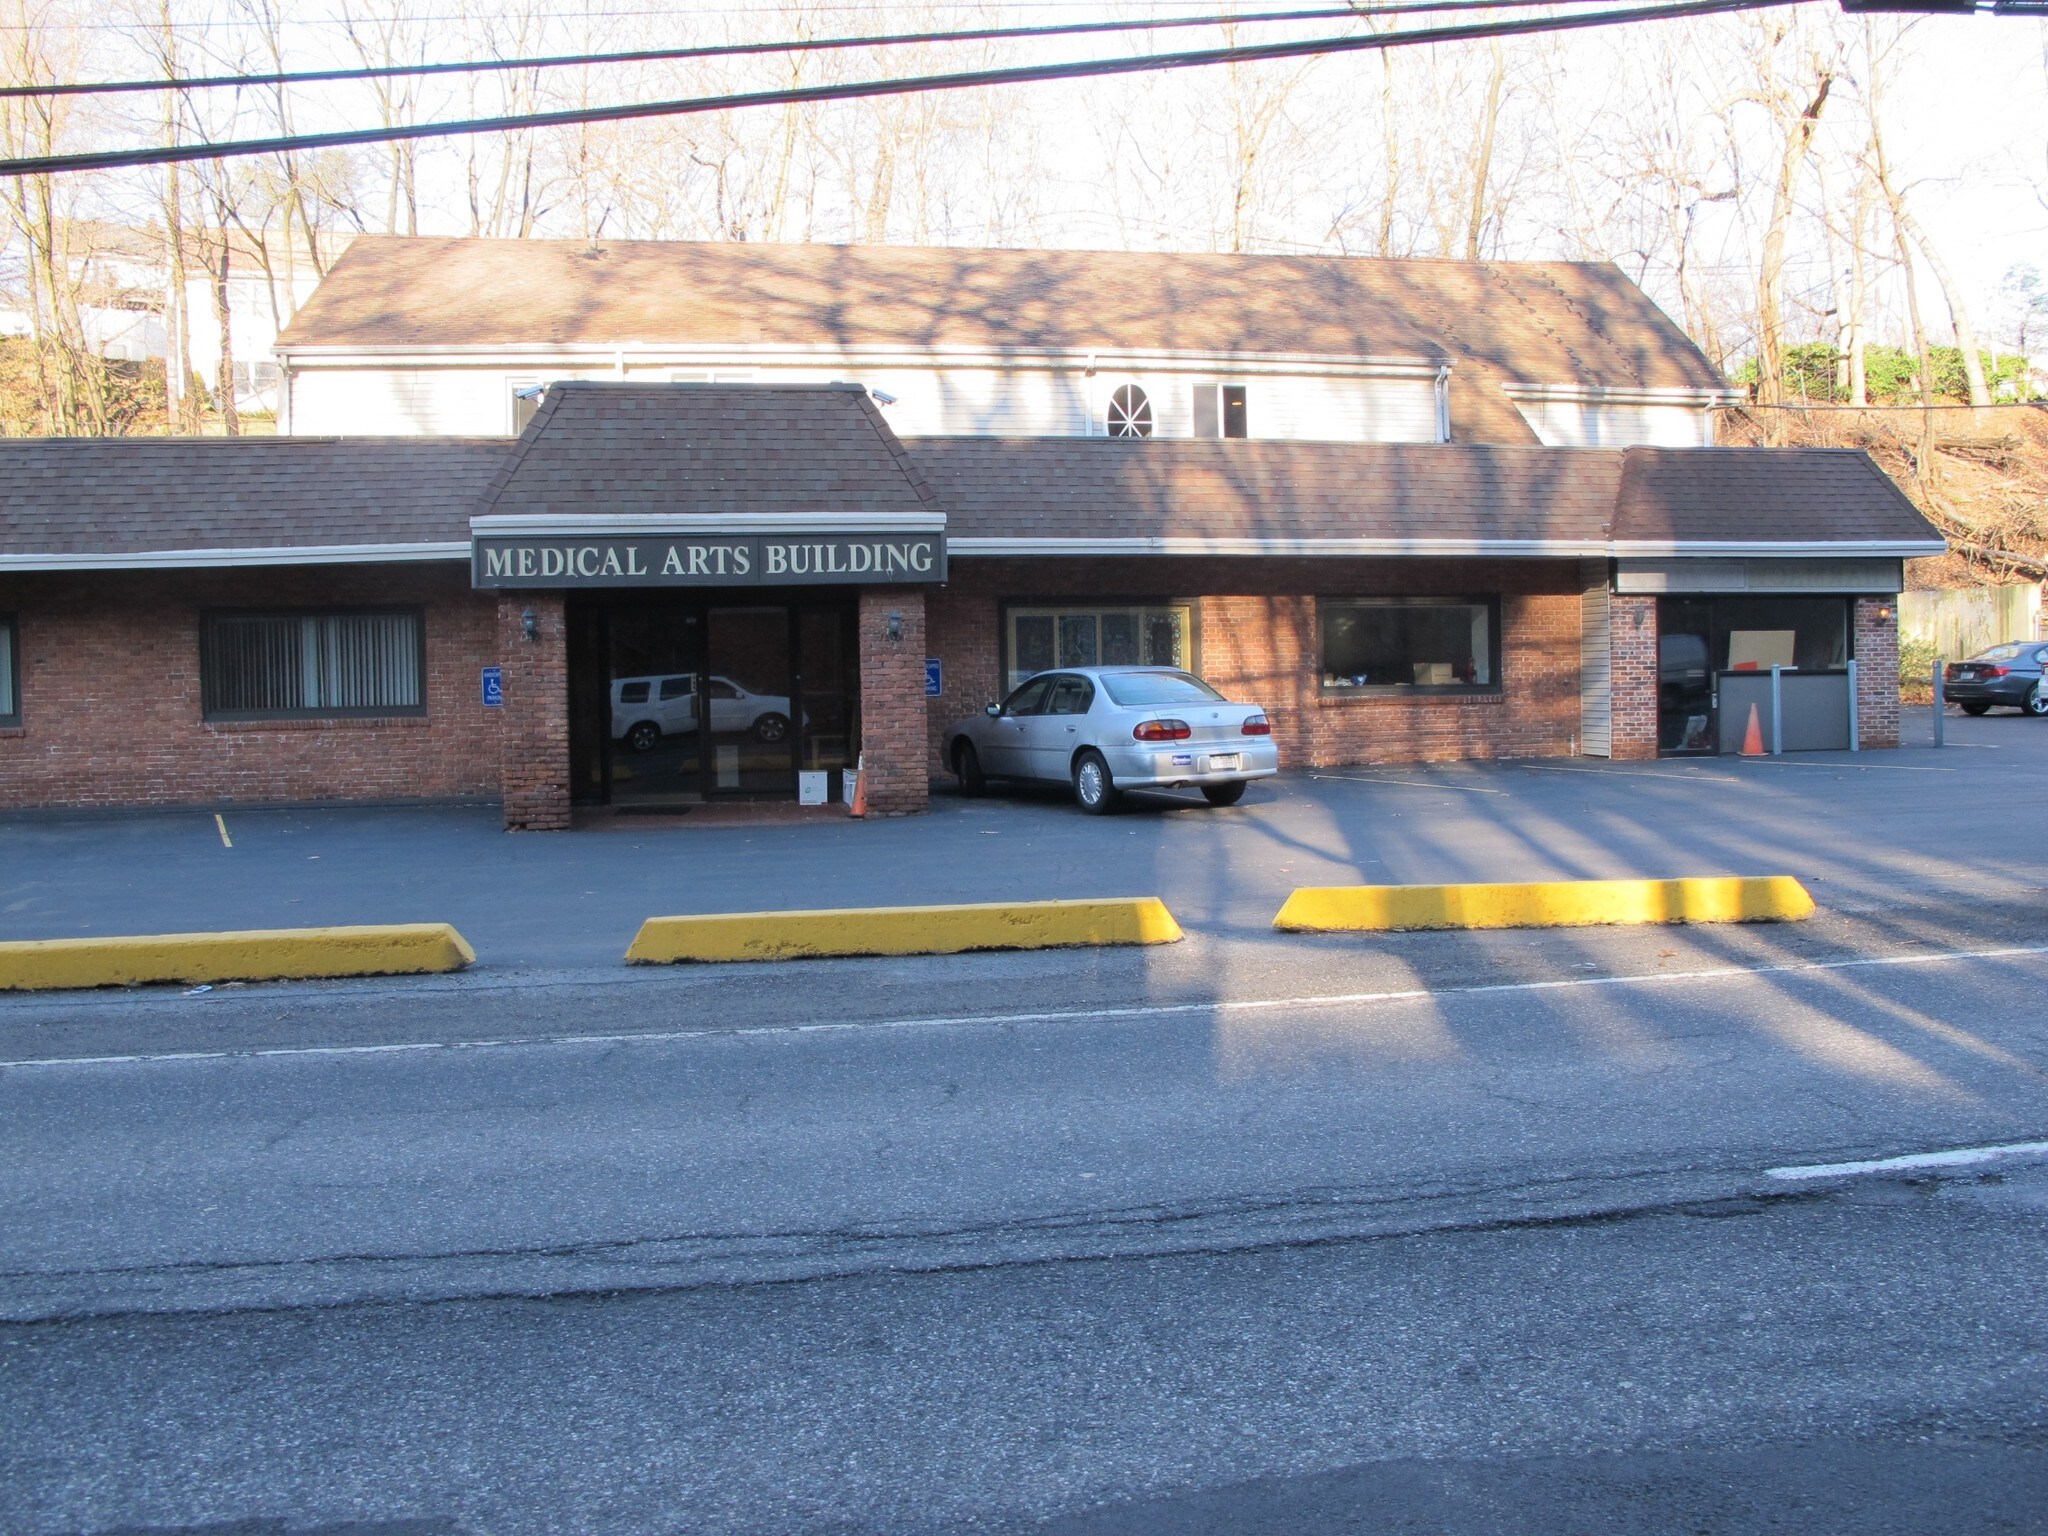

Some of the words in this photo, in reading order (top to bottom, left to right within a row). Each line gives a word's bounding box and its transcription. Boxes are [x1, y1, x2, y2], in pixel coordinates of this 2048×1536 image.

[484, 546, 648, 577] MEDICAL
[660, 545, 750, 575] ARTS
[765, 543, 934, 574] BUILDING
